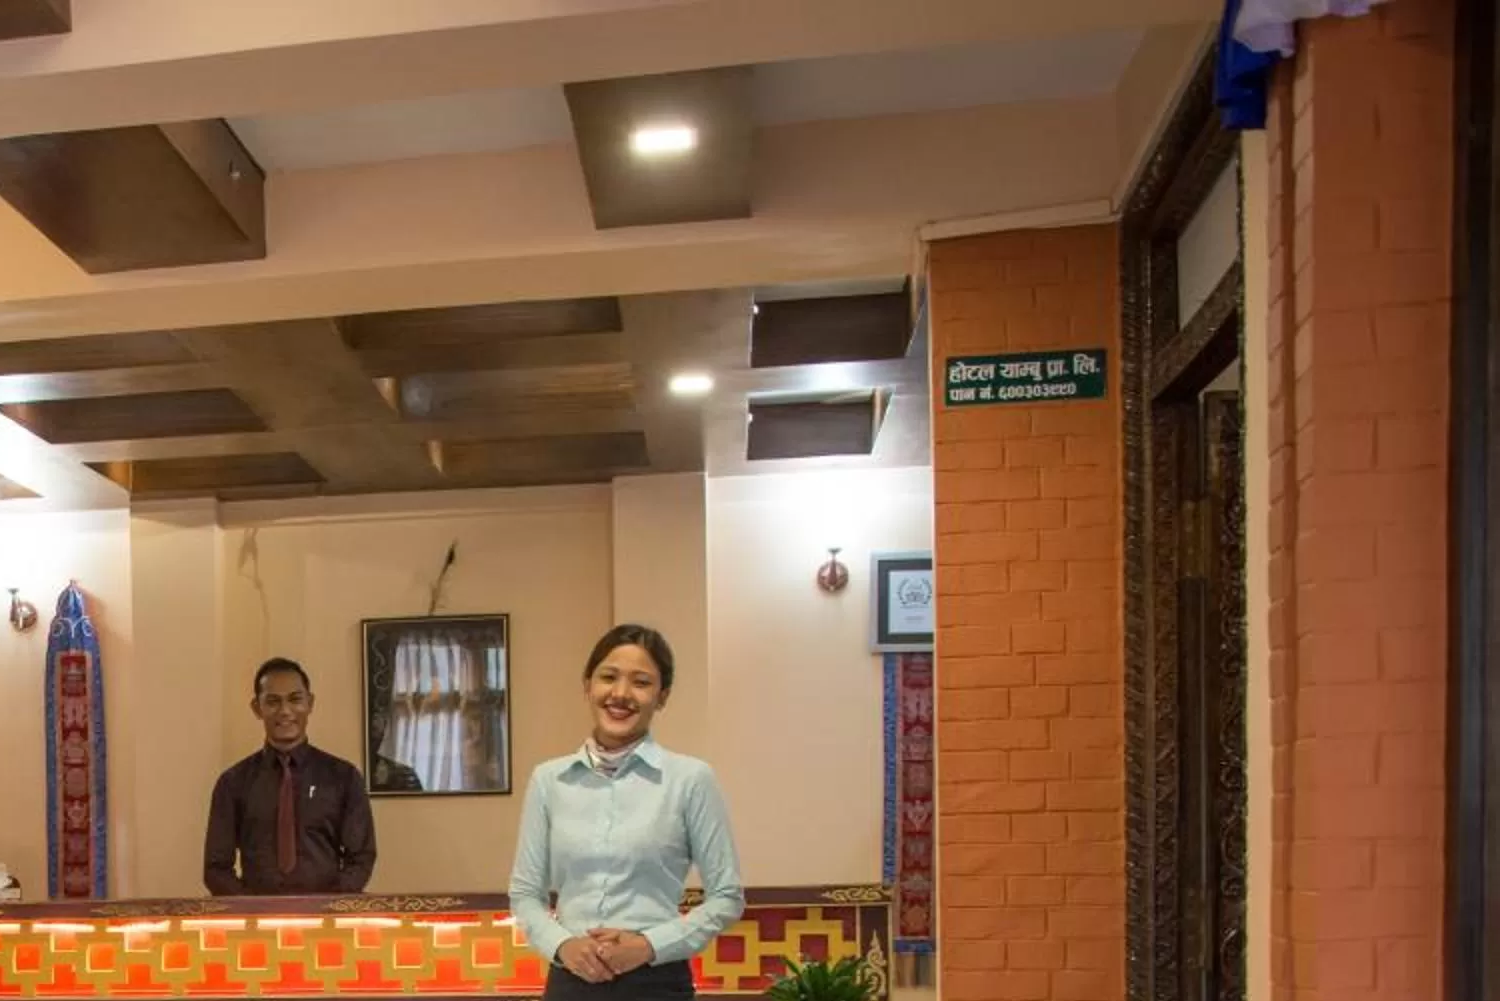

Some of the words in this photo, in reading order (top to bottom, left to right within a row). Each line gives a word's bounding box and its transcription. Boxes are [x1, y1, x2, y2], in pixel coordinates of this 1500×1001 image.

[949, 361, 996, 383] होटल
[1046, 359, 1069, 378] प्रा.
[1073, 353, 1100, 375] लि.
